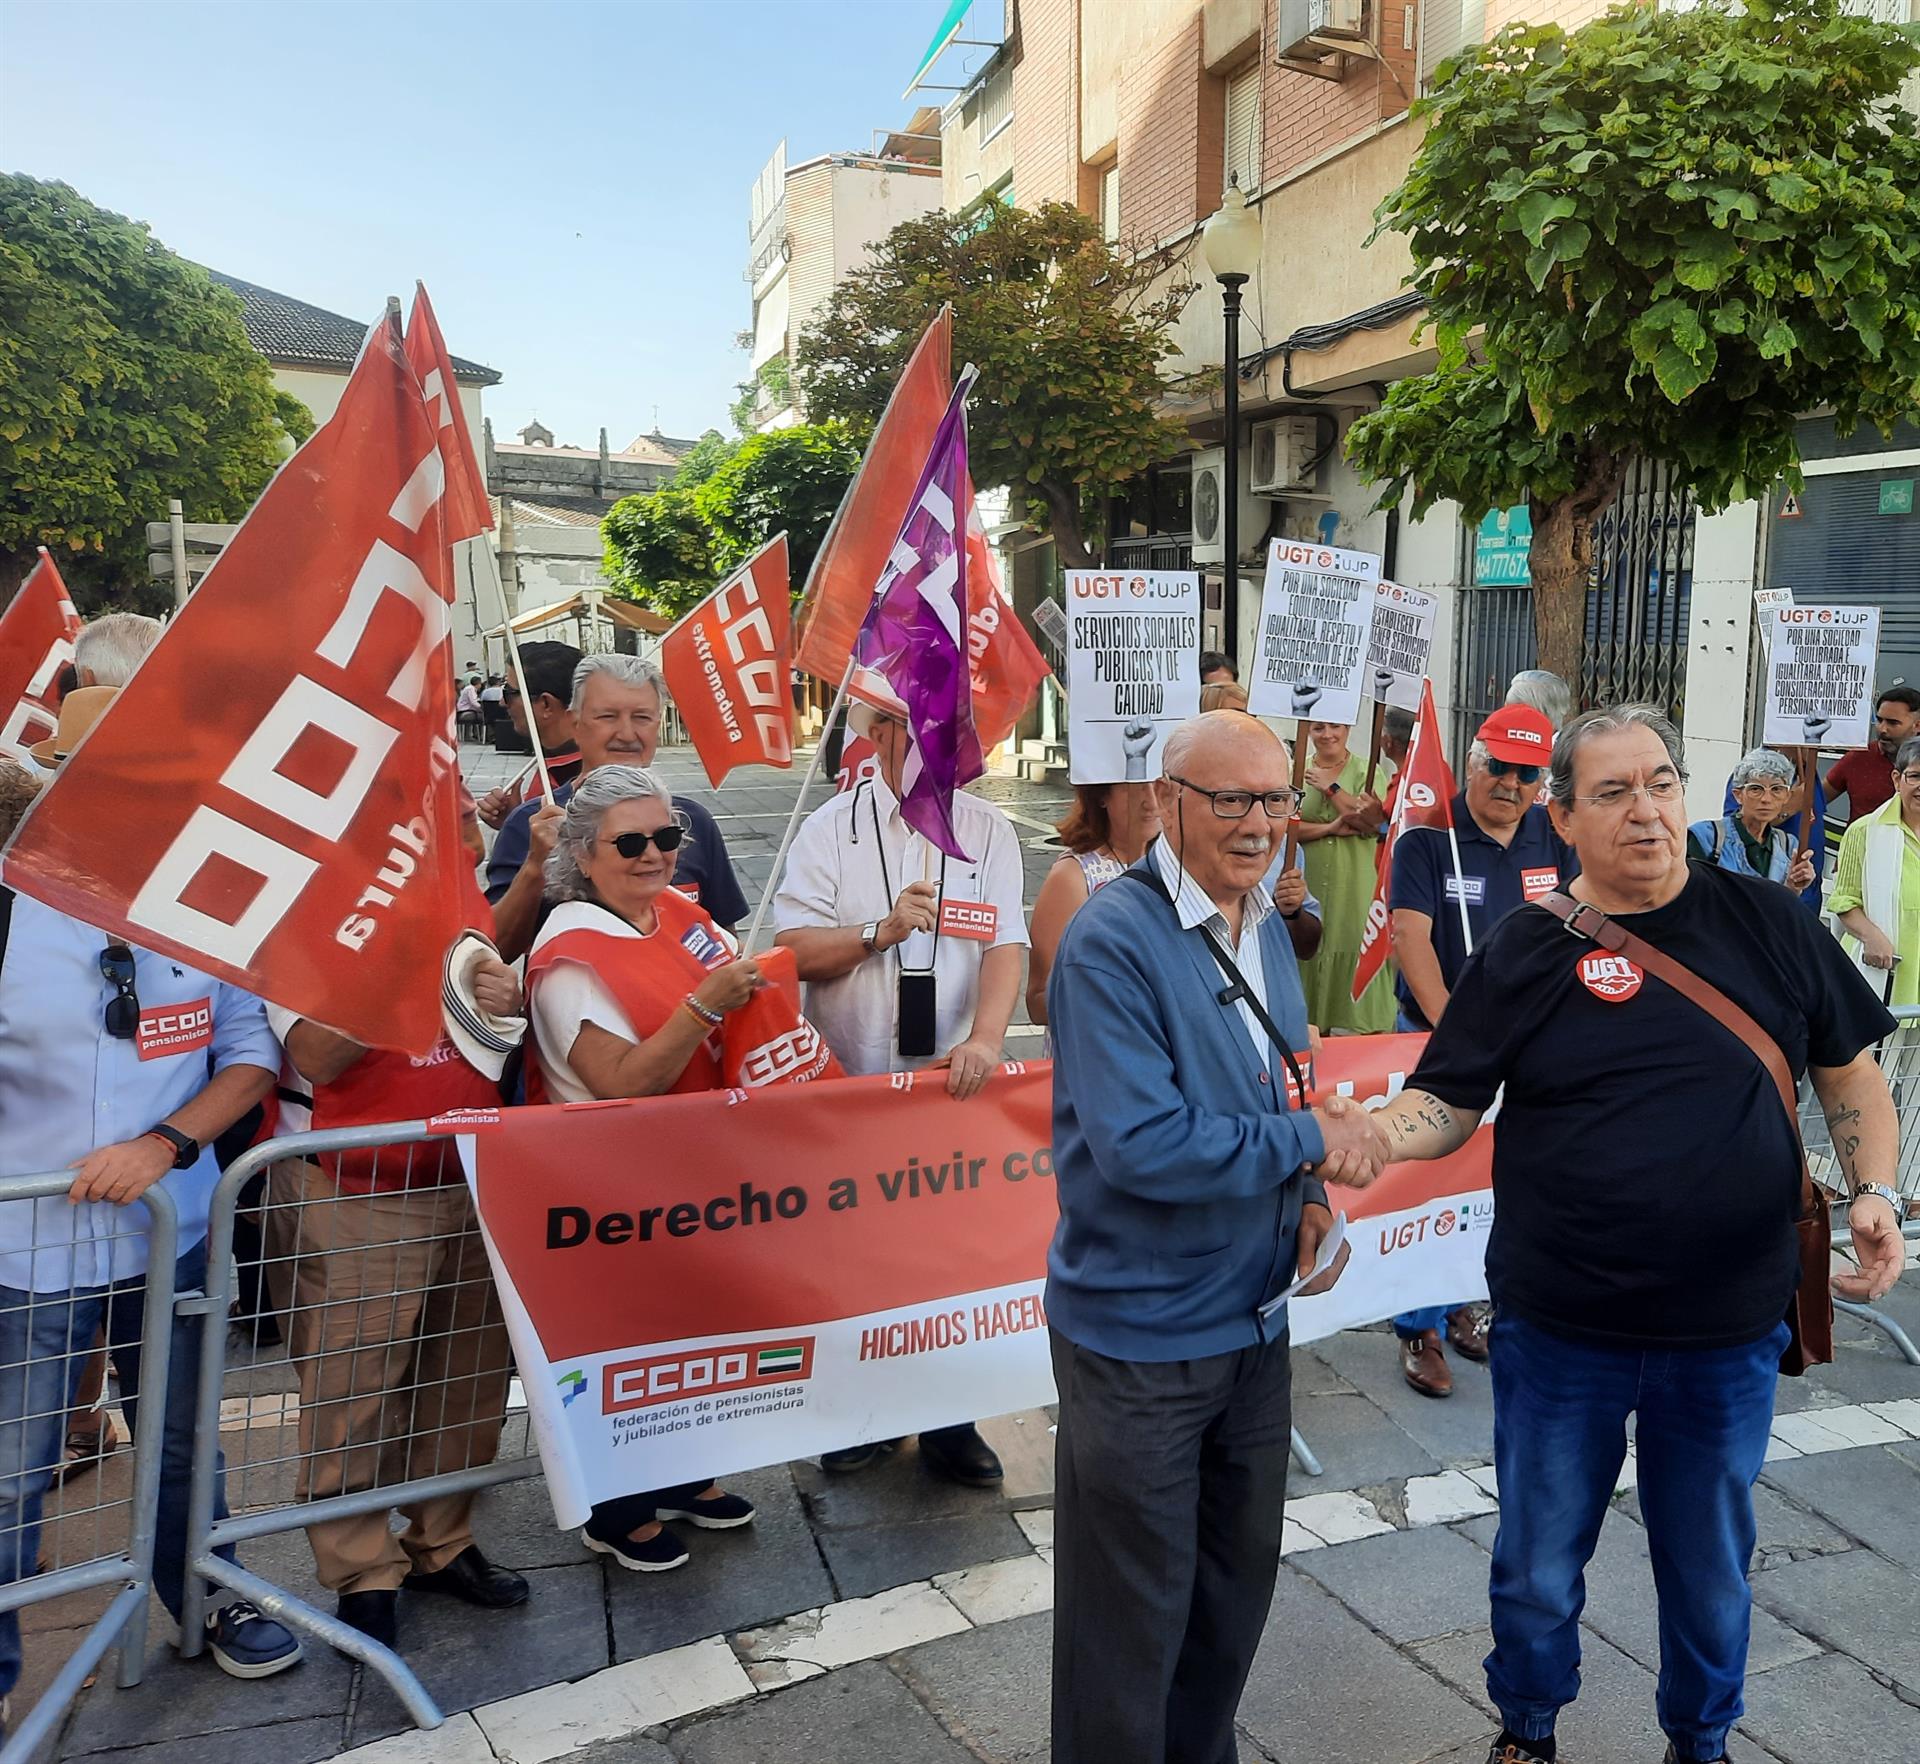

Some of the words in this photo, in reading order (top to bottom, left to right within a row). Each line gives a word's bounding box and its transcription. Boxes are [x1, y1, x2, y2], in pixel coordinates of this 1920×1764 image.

[1277, 544, 1314, 565] UGT
[1342, 559, 1369, 574] UJP
[1074, 576, 1125, 599] UGT
[1157, 583, 1191, 599] UJP
[1282, 571, 1301, 594] POR
[1301, 574, 1318, 596] UNA
[1320, 576, 1360, 602] SOCIEDAD
[1376, 583, 1393, 597] GT
[1408, 595, 1429, 608] UJP
[1289, 594, 1341, 621] EQUILIBRADA
[1341, 602, 1348, 622] E
[1373, 604, 1415, 636] ESTABLECER
[1415, 618, 1422, 636] Y
[1780, 609, 1815, 624] UGT
[1842, 613, 1869, 625] UJP
[1074, 616, 1141, 650] SERVICIOS
[1144, 616, 1195, 649] SOCIALES
[1265, 614, 1318, 642] IGUALITARIA,
[1320, 621, 1356, 646] RESPETO
[1357, 625, 1364, 646] Y
[1391, 630, 1429, 658] SERVICIOS
[1787, 628, 1803, 646] POR
[1805, 629, 1820, 646] UNA
[1822, 629, 1861, 647] SOCIEDAD
[715, 567, 792, 763] CCOO
[1155, 650, 1162, 682] Y
[1167, 650, 1180, 682] DE
[1330, 644, 1342, 666] DE
[1343, 645, 1359, 668] LAS
[1389, 650, 1422, 675] RURALES
[1794, 646, 1844, 666] EQUILIBRADA
[1846, 646, 1850, 664] E
[692, 621, 743, 744] extremadura
[1775, 663, 1823, 682] IGUALITARIA,
[1826, 665, 1860, 682] RESPETO
[1861, 665, 1867, 682] Y
[1114, 683, 1164, 716] CALIDAD
[1838, 681, 1848, 699] DE
[1850, 682, 1864, 699] LAS
[1507, 728, 1542, 745] CCOO
[943, 920, 994, 933] pensionistas
[944, 906, 995, 925] CCOO
[1583, 956, 1633, 981] UGT
[139, 1008, 209, 1037] CCOO
[142, 1028, 210, 1051] pensionistas
[430, 1113, 500, 1127] pensionistas
[546, 1181, 808, 1250] Derecho
[828, 1178, 858, 1211] a
[877, 1151, 988, 1202] vivir
[1380, 1214, 1431, 1256] UGT
[1473, 1201, 1493, 1217] UJ
[860, 1309, 968, 1362] HICIMOS
[613, 1352, 749, 1404] CCOO
[613, 1404, 690, 1430] federación
[694, 1400, 711, 1413] de
[715, 1385, 804, 1411] pensionistas
[612, 1434, 621, 1448] y
[624, 1419, 691, 1445] jubilados
[696, 1414, 713, 1427] de
[717, 1398, 804, 1422] extremadura
